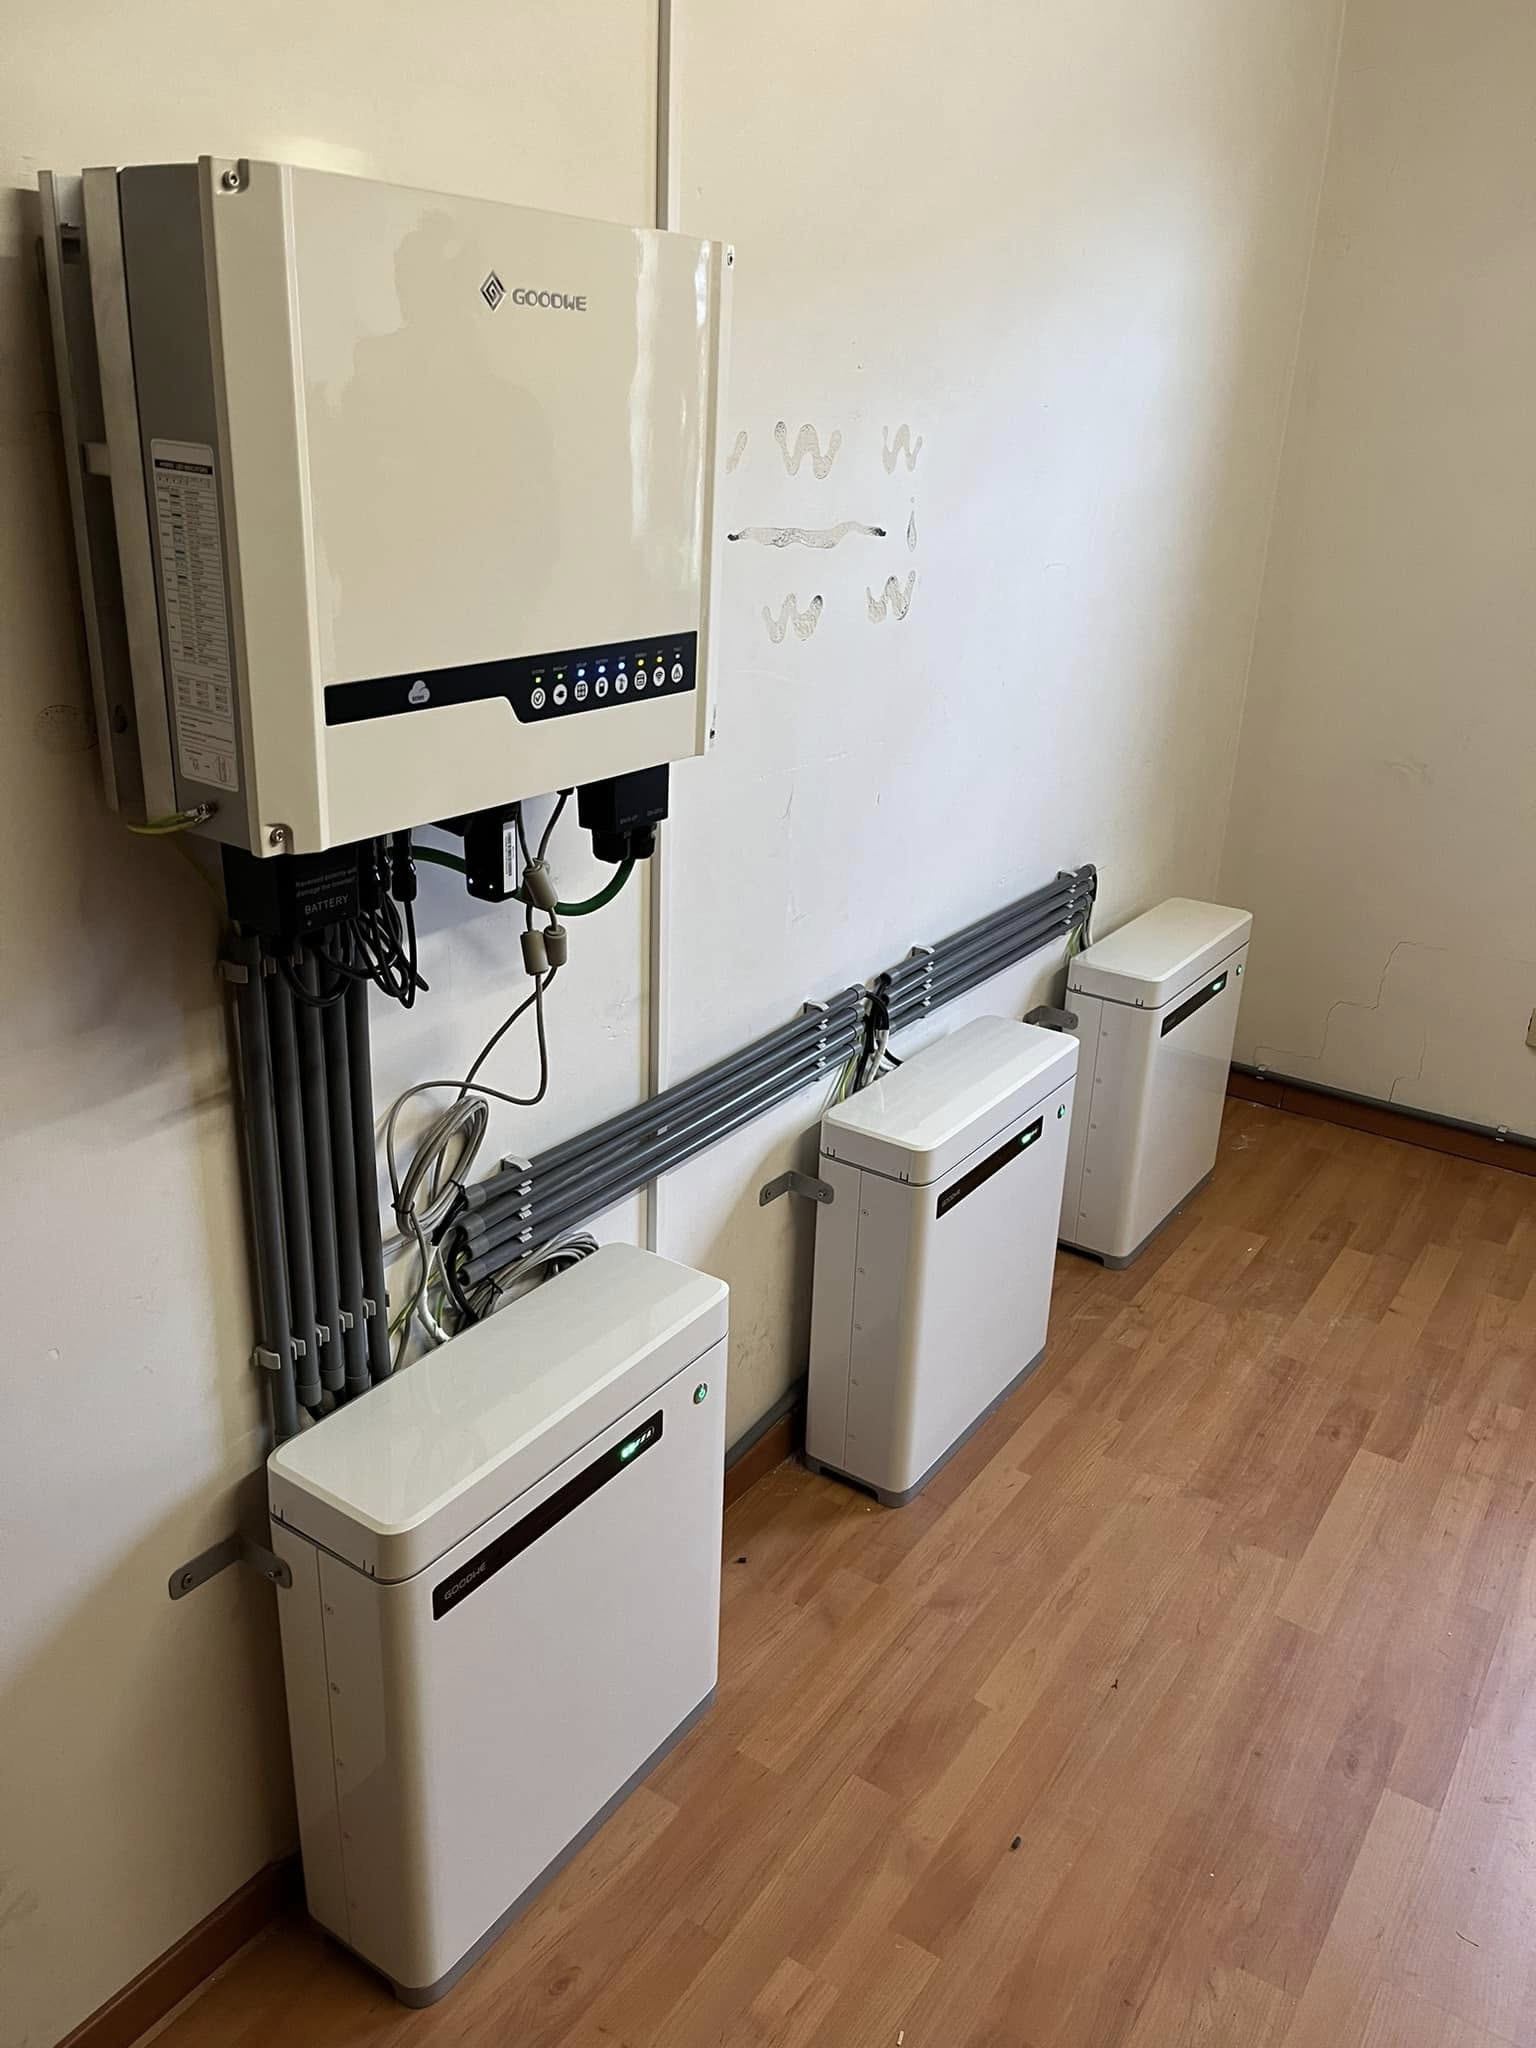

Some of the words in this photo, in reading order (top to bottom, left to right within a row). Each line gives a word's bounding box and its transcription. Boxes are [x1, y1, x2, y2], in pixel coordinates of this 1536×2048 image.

[512, 288, 587, 312] GOODWE
[304, 894, 349, 915] BATTERY
[444, 1560, 487, 1600] GOODWE
